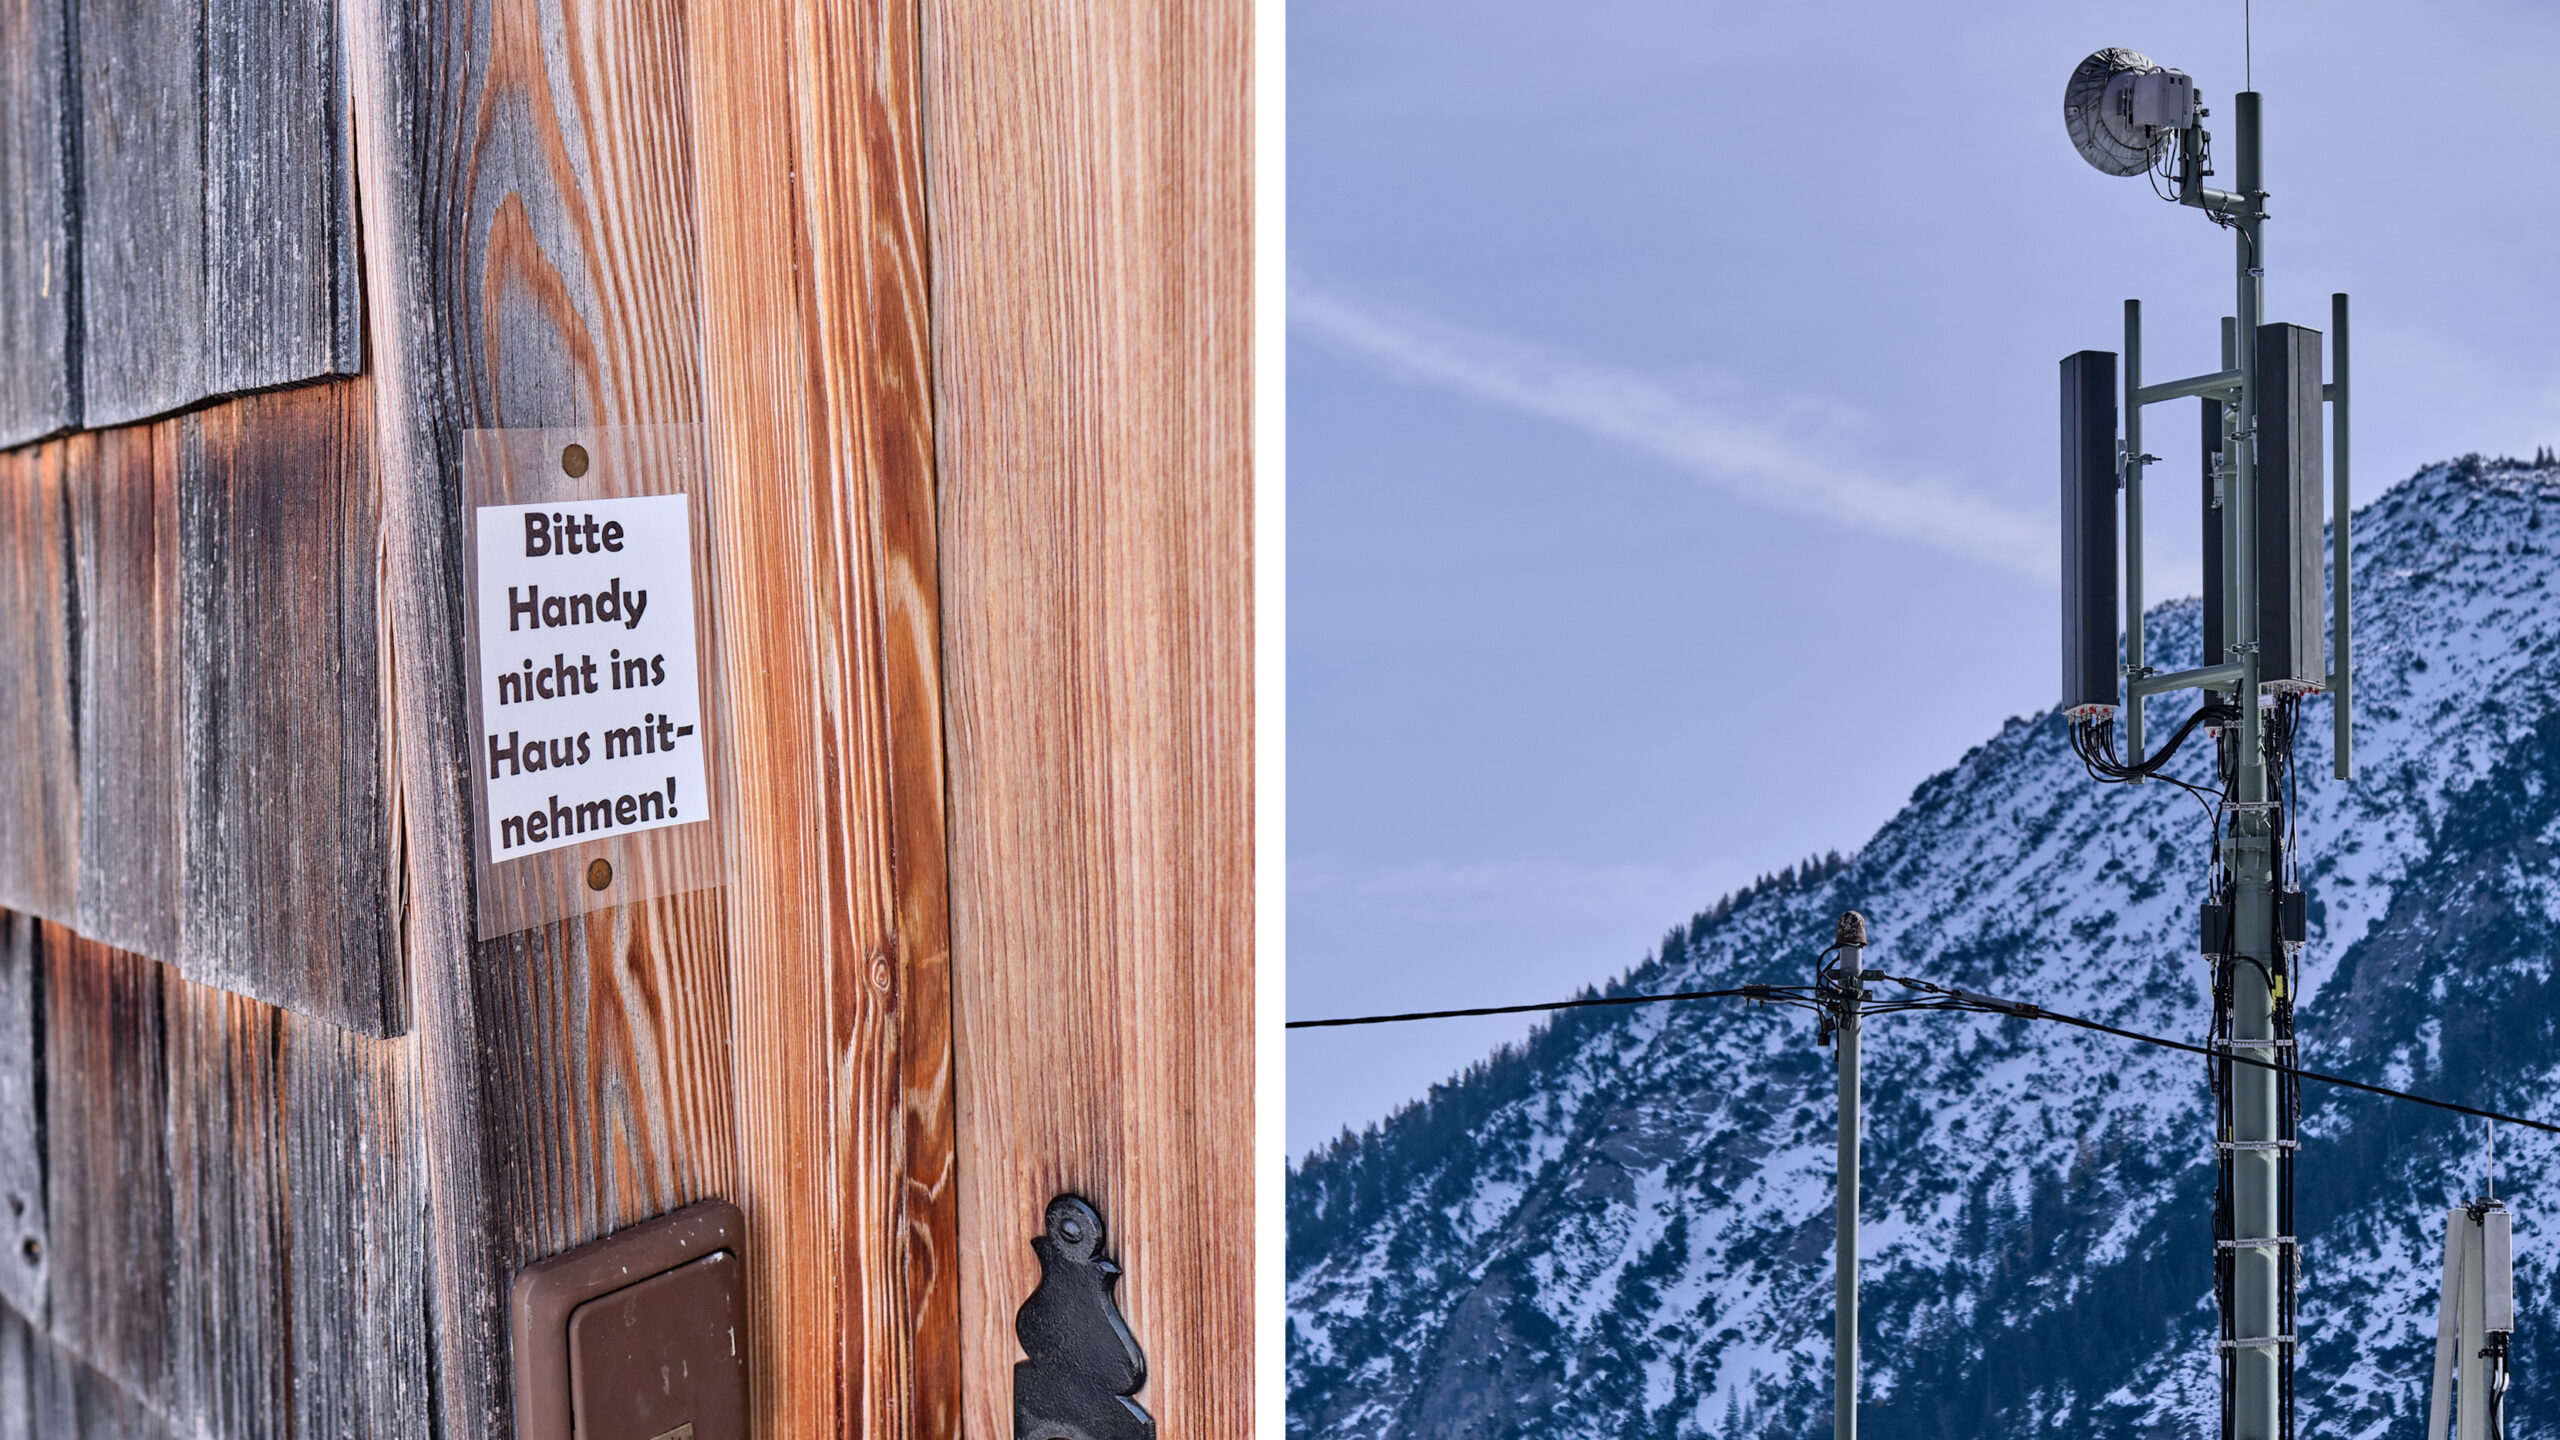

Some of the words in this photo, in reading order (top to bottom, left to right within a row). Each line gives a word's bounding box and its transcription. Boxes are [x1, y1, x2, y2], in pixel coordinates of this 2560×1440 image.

[525, 512, 625, 557] Bitte
[508, 577, 648, 632] Handy
[498, 652, 599, 705] nicht
[610, 648, 666, 691] ins
[488, 730, 591, 780] Haus
[605, 713, 694, 760] mit-
[501, 776, 678, 850] nehmen!
